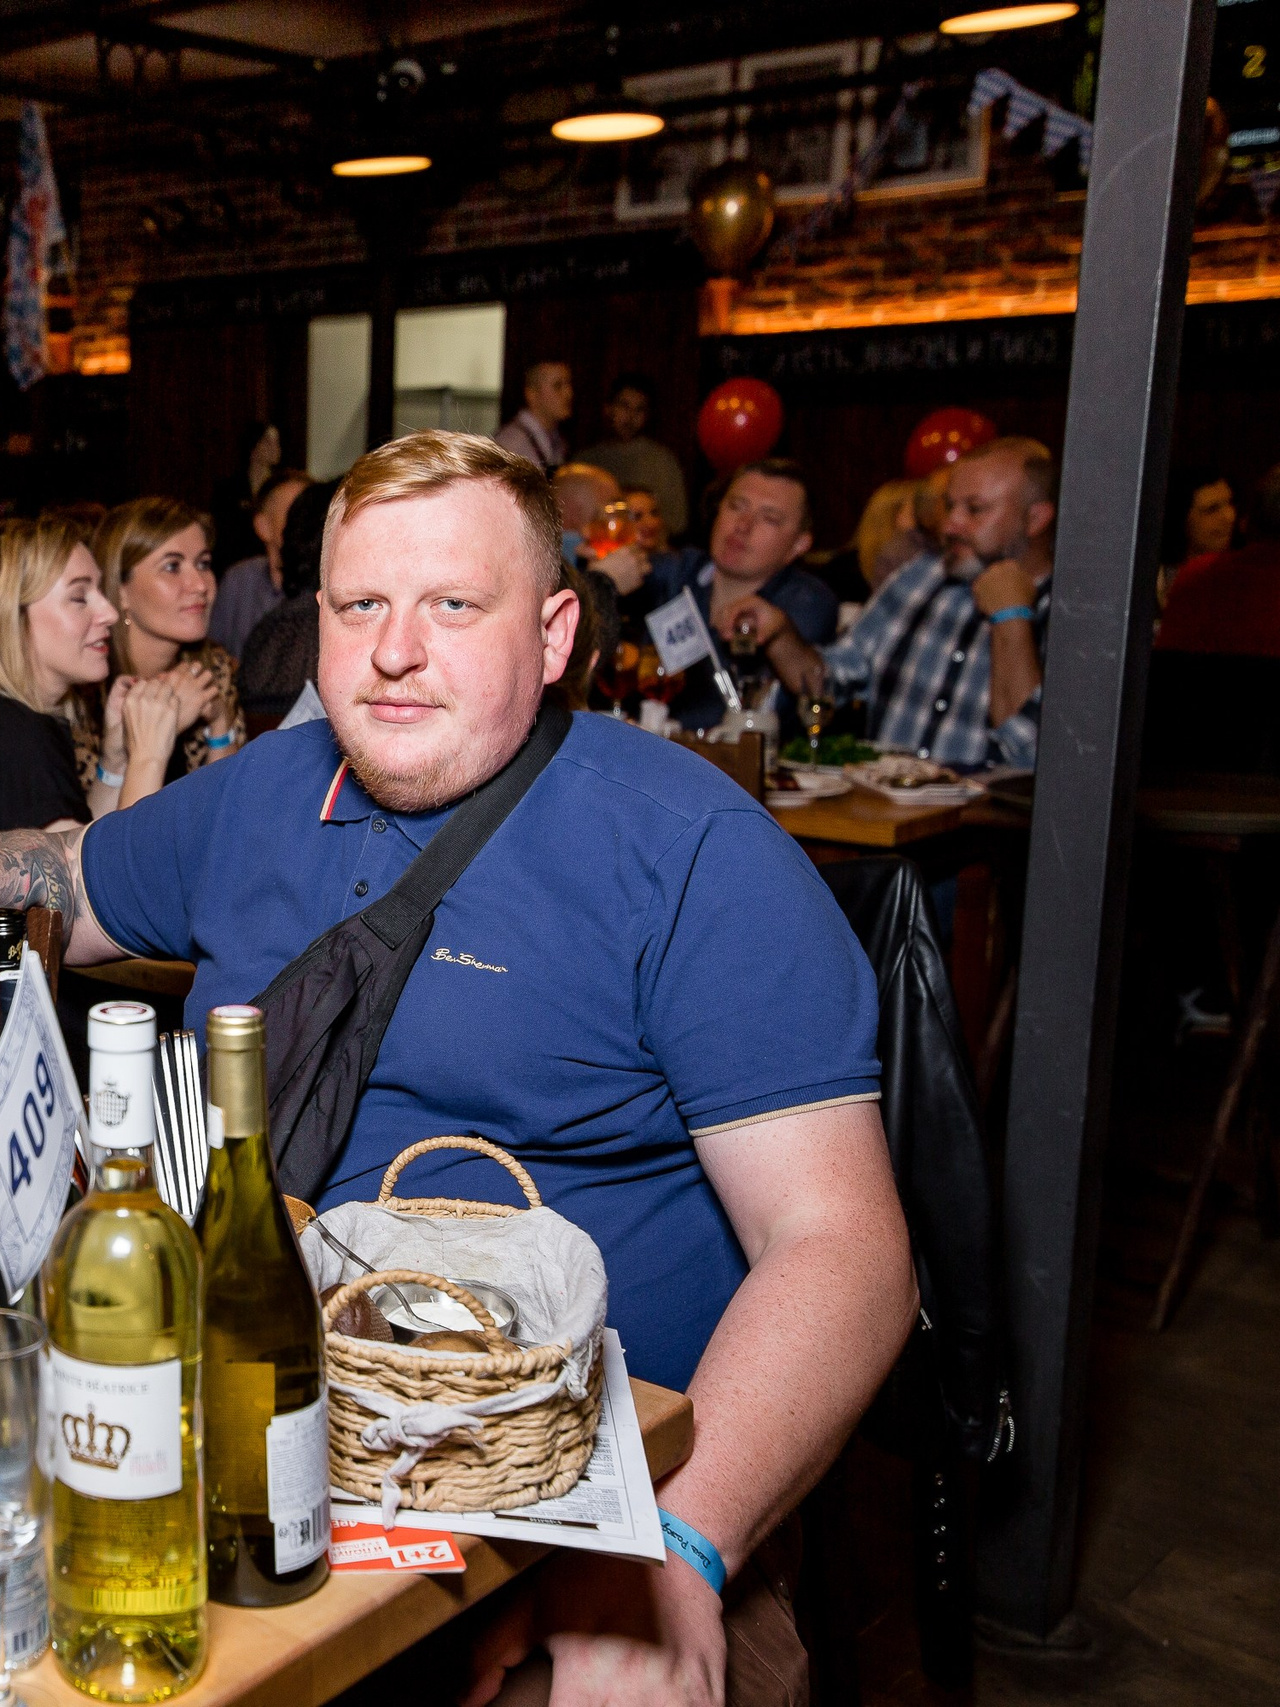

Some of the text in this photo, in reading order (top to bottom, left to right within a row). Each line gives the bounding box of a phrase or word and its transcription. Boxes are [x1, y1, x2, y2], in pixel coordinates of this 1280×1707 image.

[1242, 44, 1268, 79] 2
[8, 1050, 56, 1197] 409
[397, 1545, 447, 1564] 2+1
